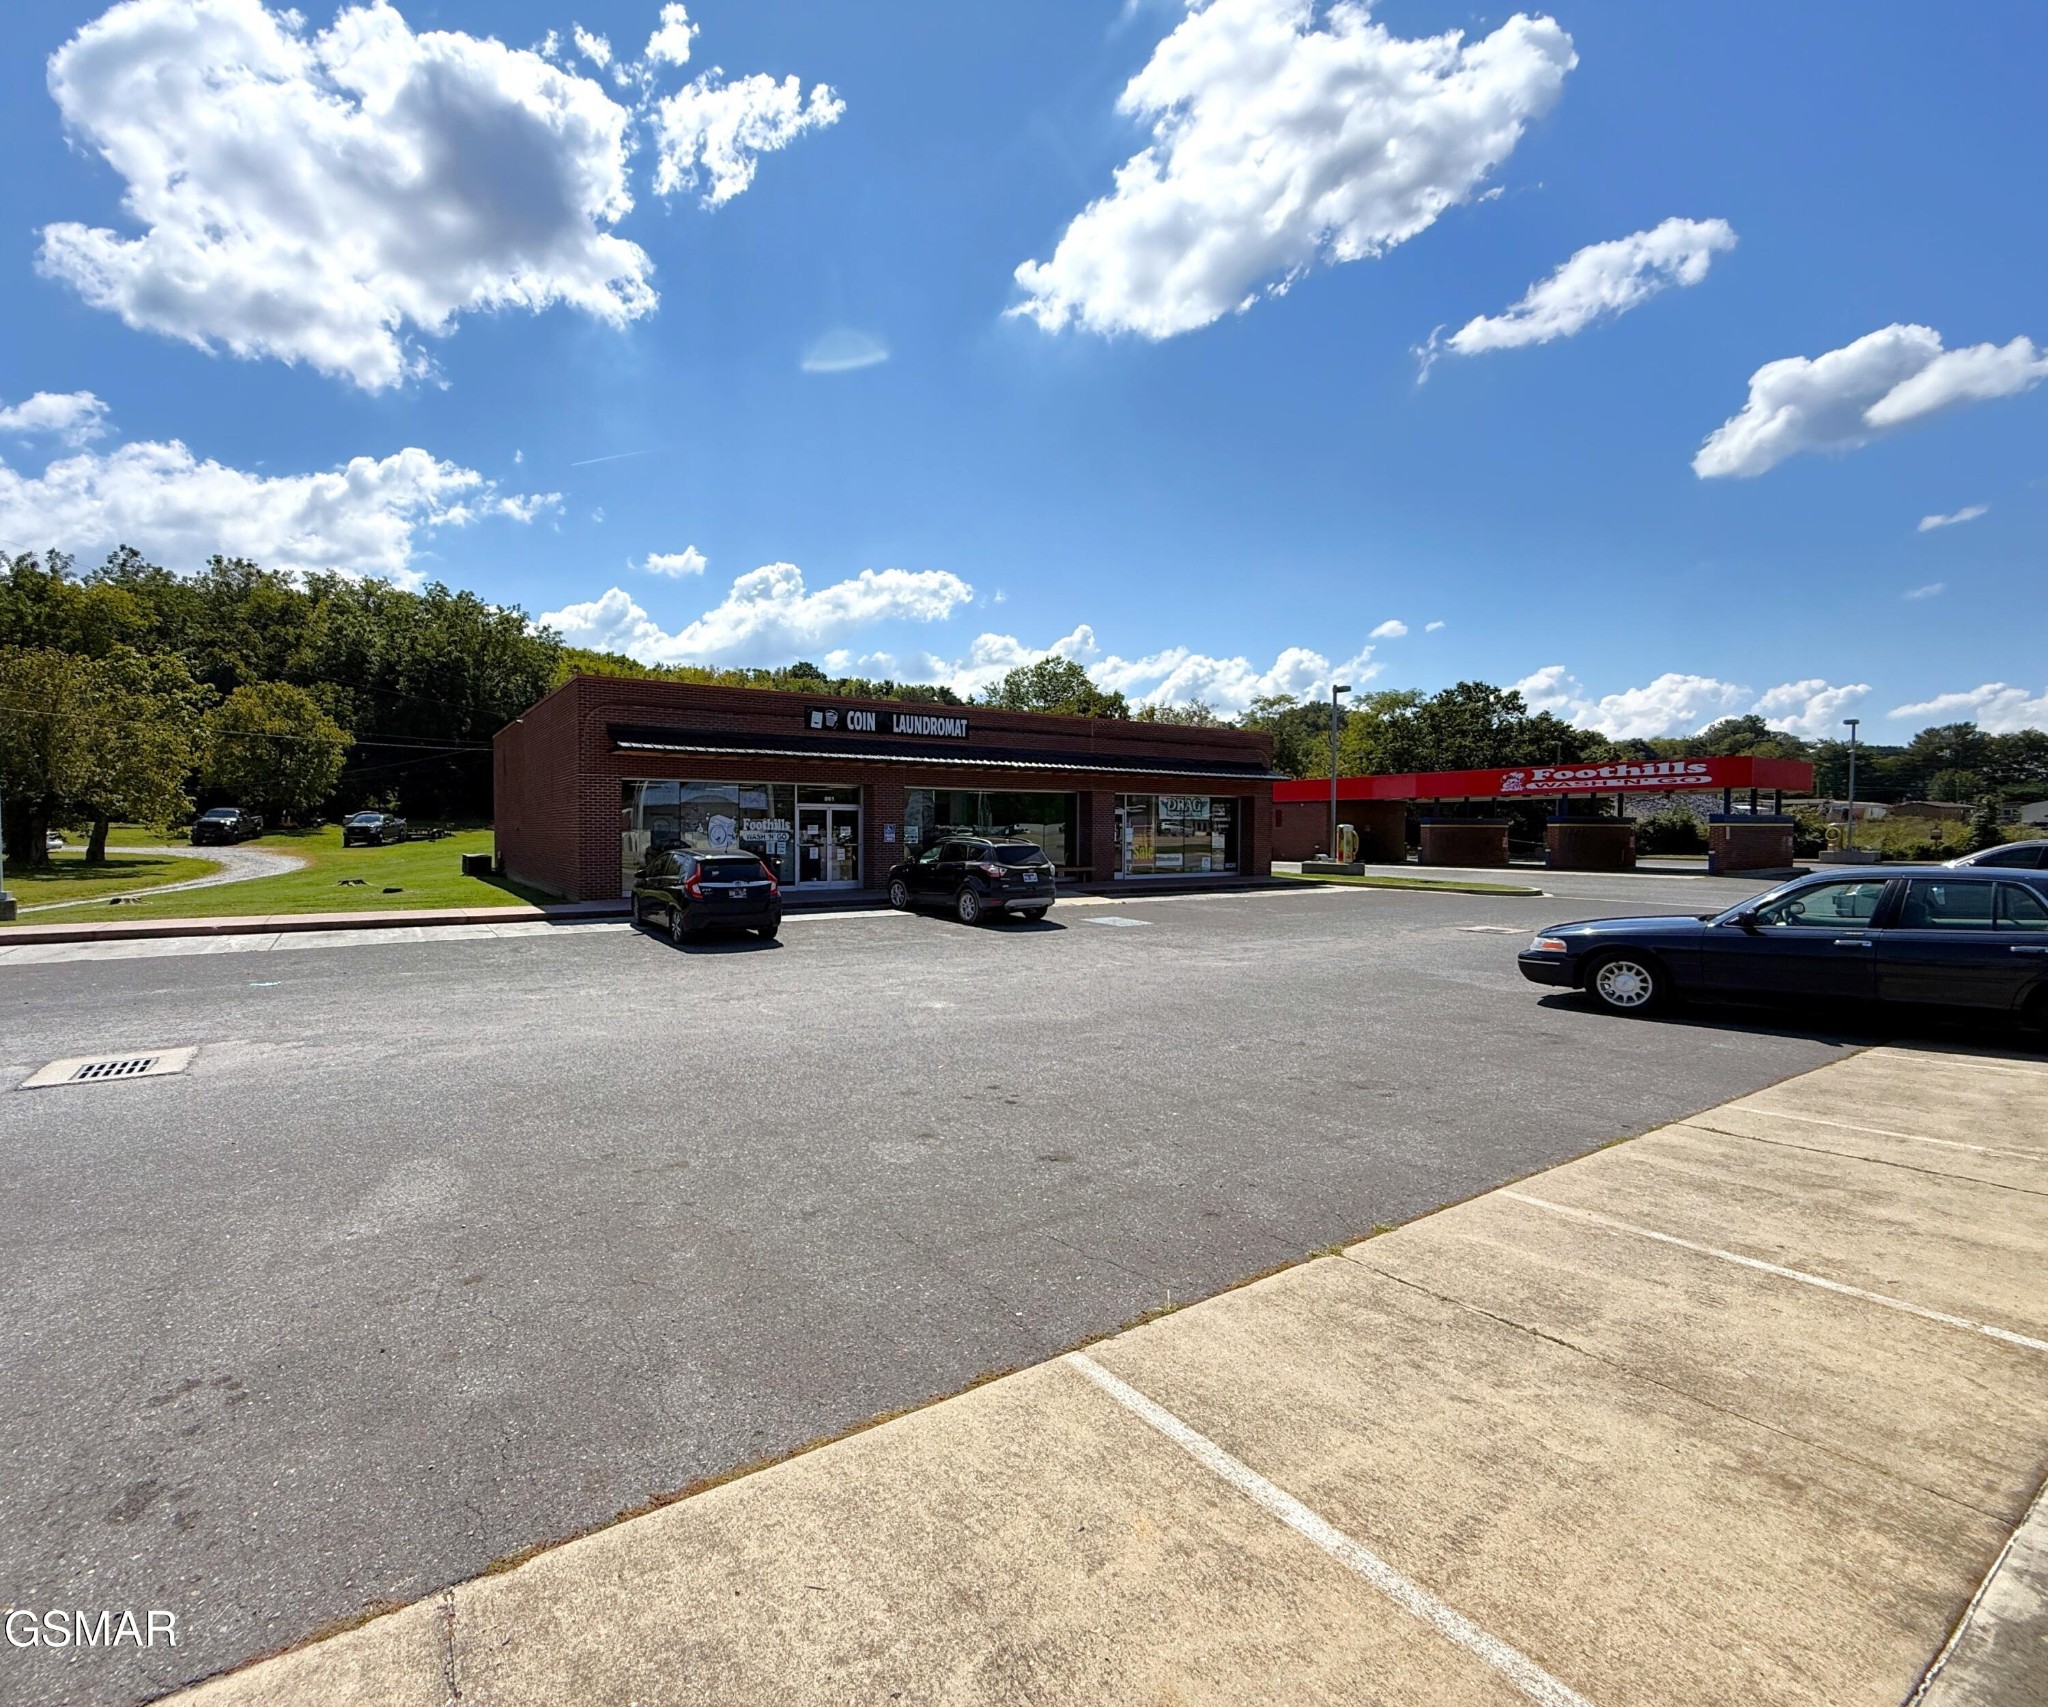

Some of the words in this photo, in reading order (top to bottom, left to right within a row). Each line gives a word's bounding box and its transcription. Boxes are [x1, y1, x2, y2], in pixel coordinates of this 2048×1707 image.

[846, 710, 876, 732] COIN
[892, 714, 968, 737] LAUNDROMAT
[1531, 761, 1708, 781] Foothills
[1167, 797, 1202, 812] DRAG
[742, 817, 791, 831] Foothills
[1133, 844, 1154, 860] Sale
